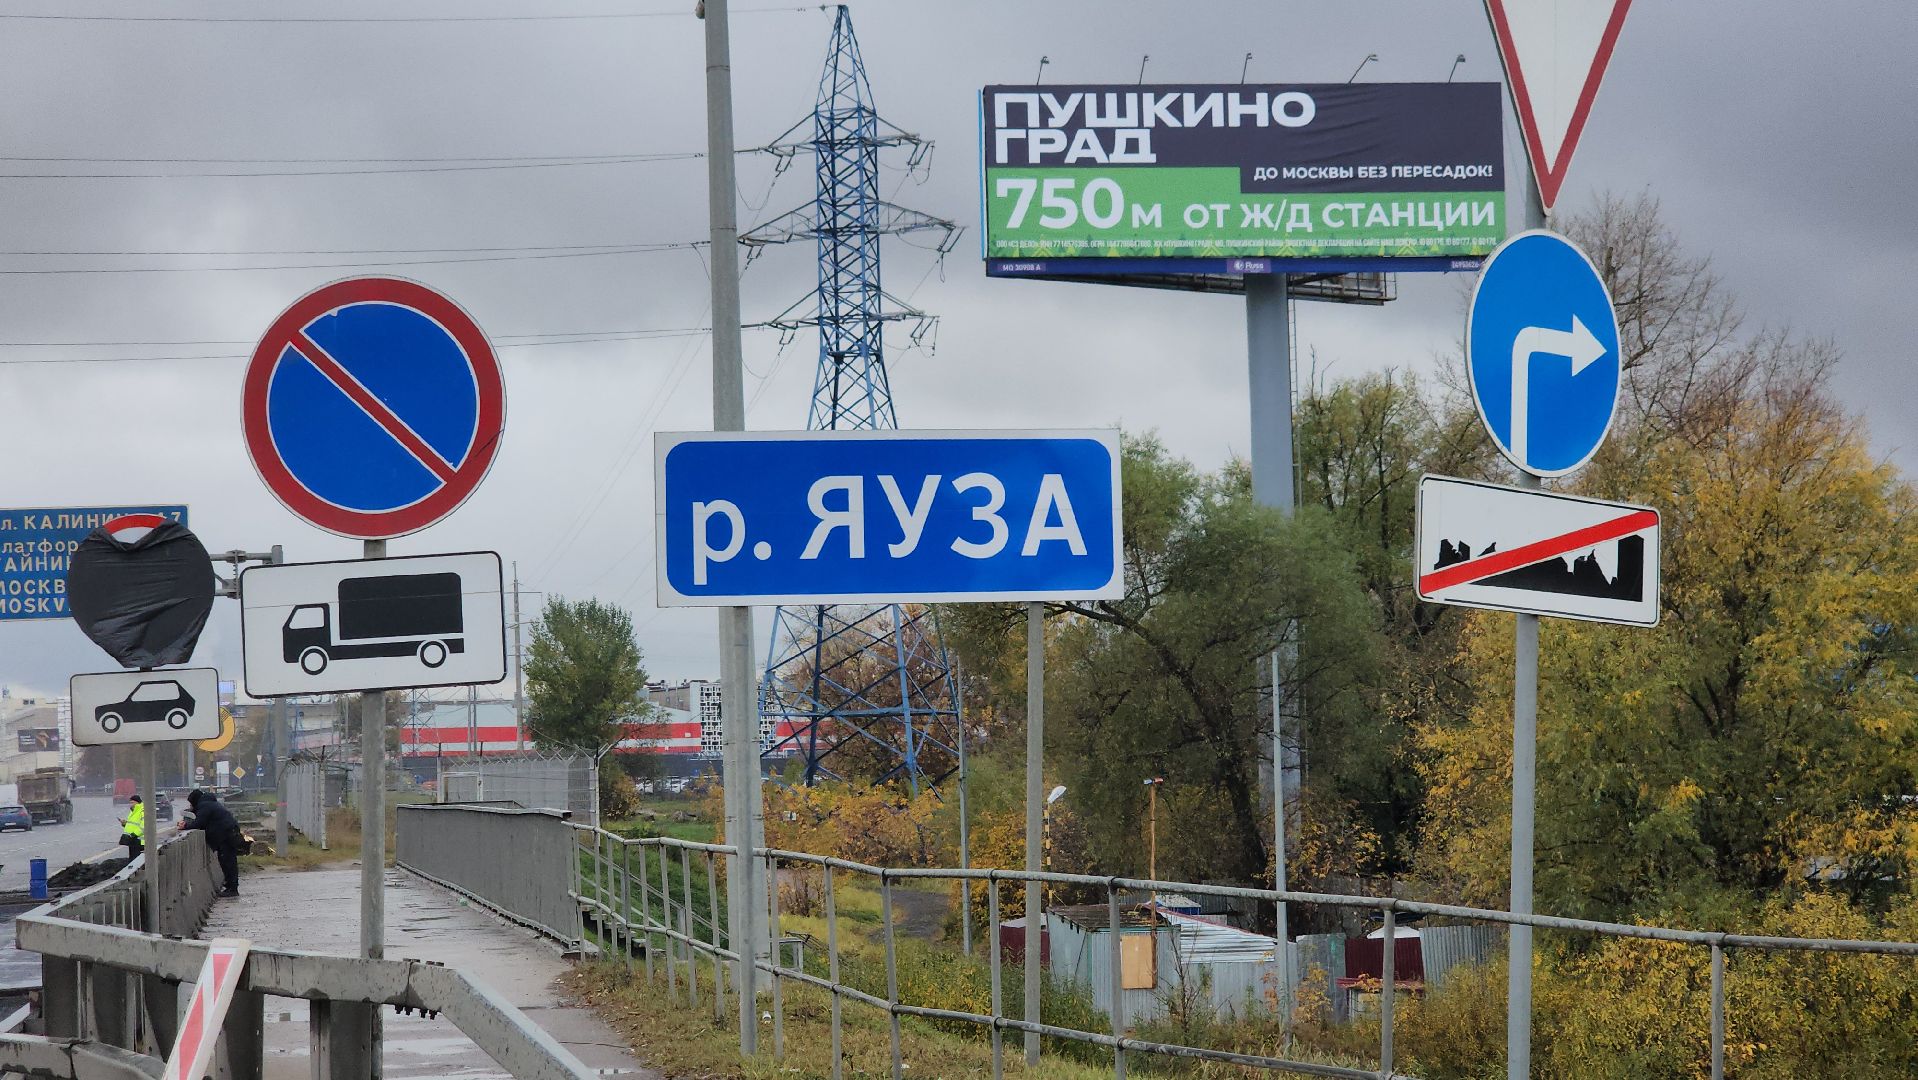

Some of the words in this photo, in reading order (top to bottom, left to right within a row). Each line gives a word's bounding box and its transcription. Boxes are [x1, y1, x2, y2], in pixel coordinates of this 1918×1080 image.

[995, 92, 1316, 128] ПУШКИНО
[995, 128, 1157, 164] ГРАД
[1253, 167, 1278, 181] ДО
[1282, 167, 1354, 179] МОСКВЫ
[1357, 166, 1388, 179] БЕЗ
[1391, 165, 1493, 180] ПЕРЕСАДОК!
[996, 178, 1124, 229] 750
[1183, 203, 1230, 229] ОТ
[1240, 199, 1313, 233] Ж/Д
[1322, 201, 1496, 232] СТАНЦИИ
[692, 499, 772, 585] р.
[800, 472, 1088, 560] ЯУЗА
[0, 552, 72, 573] АЙНИ
